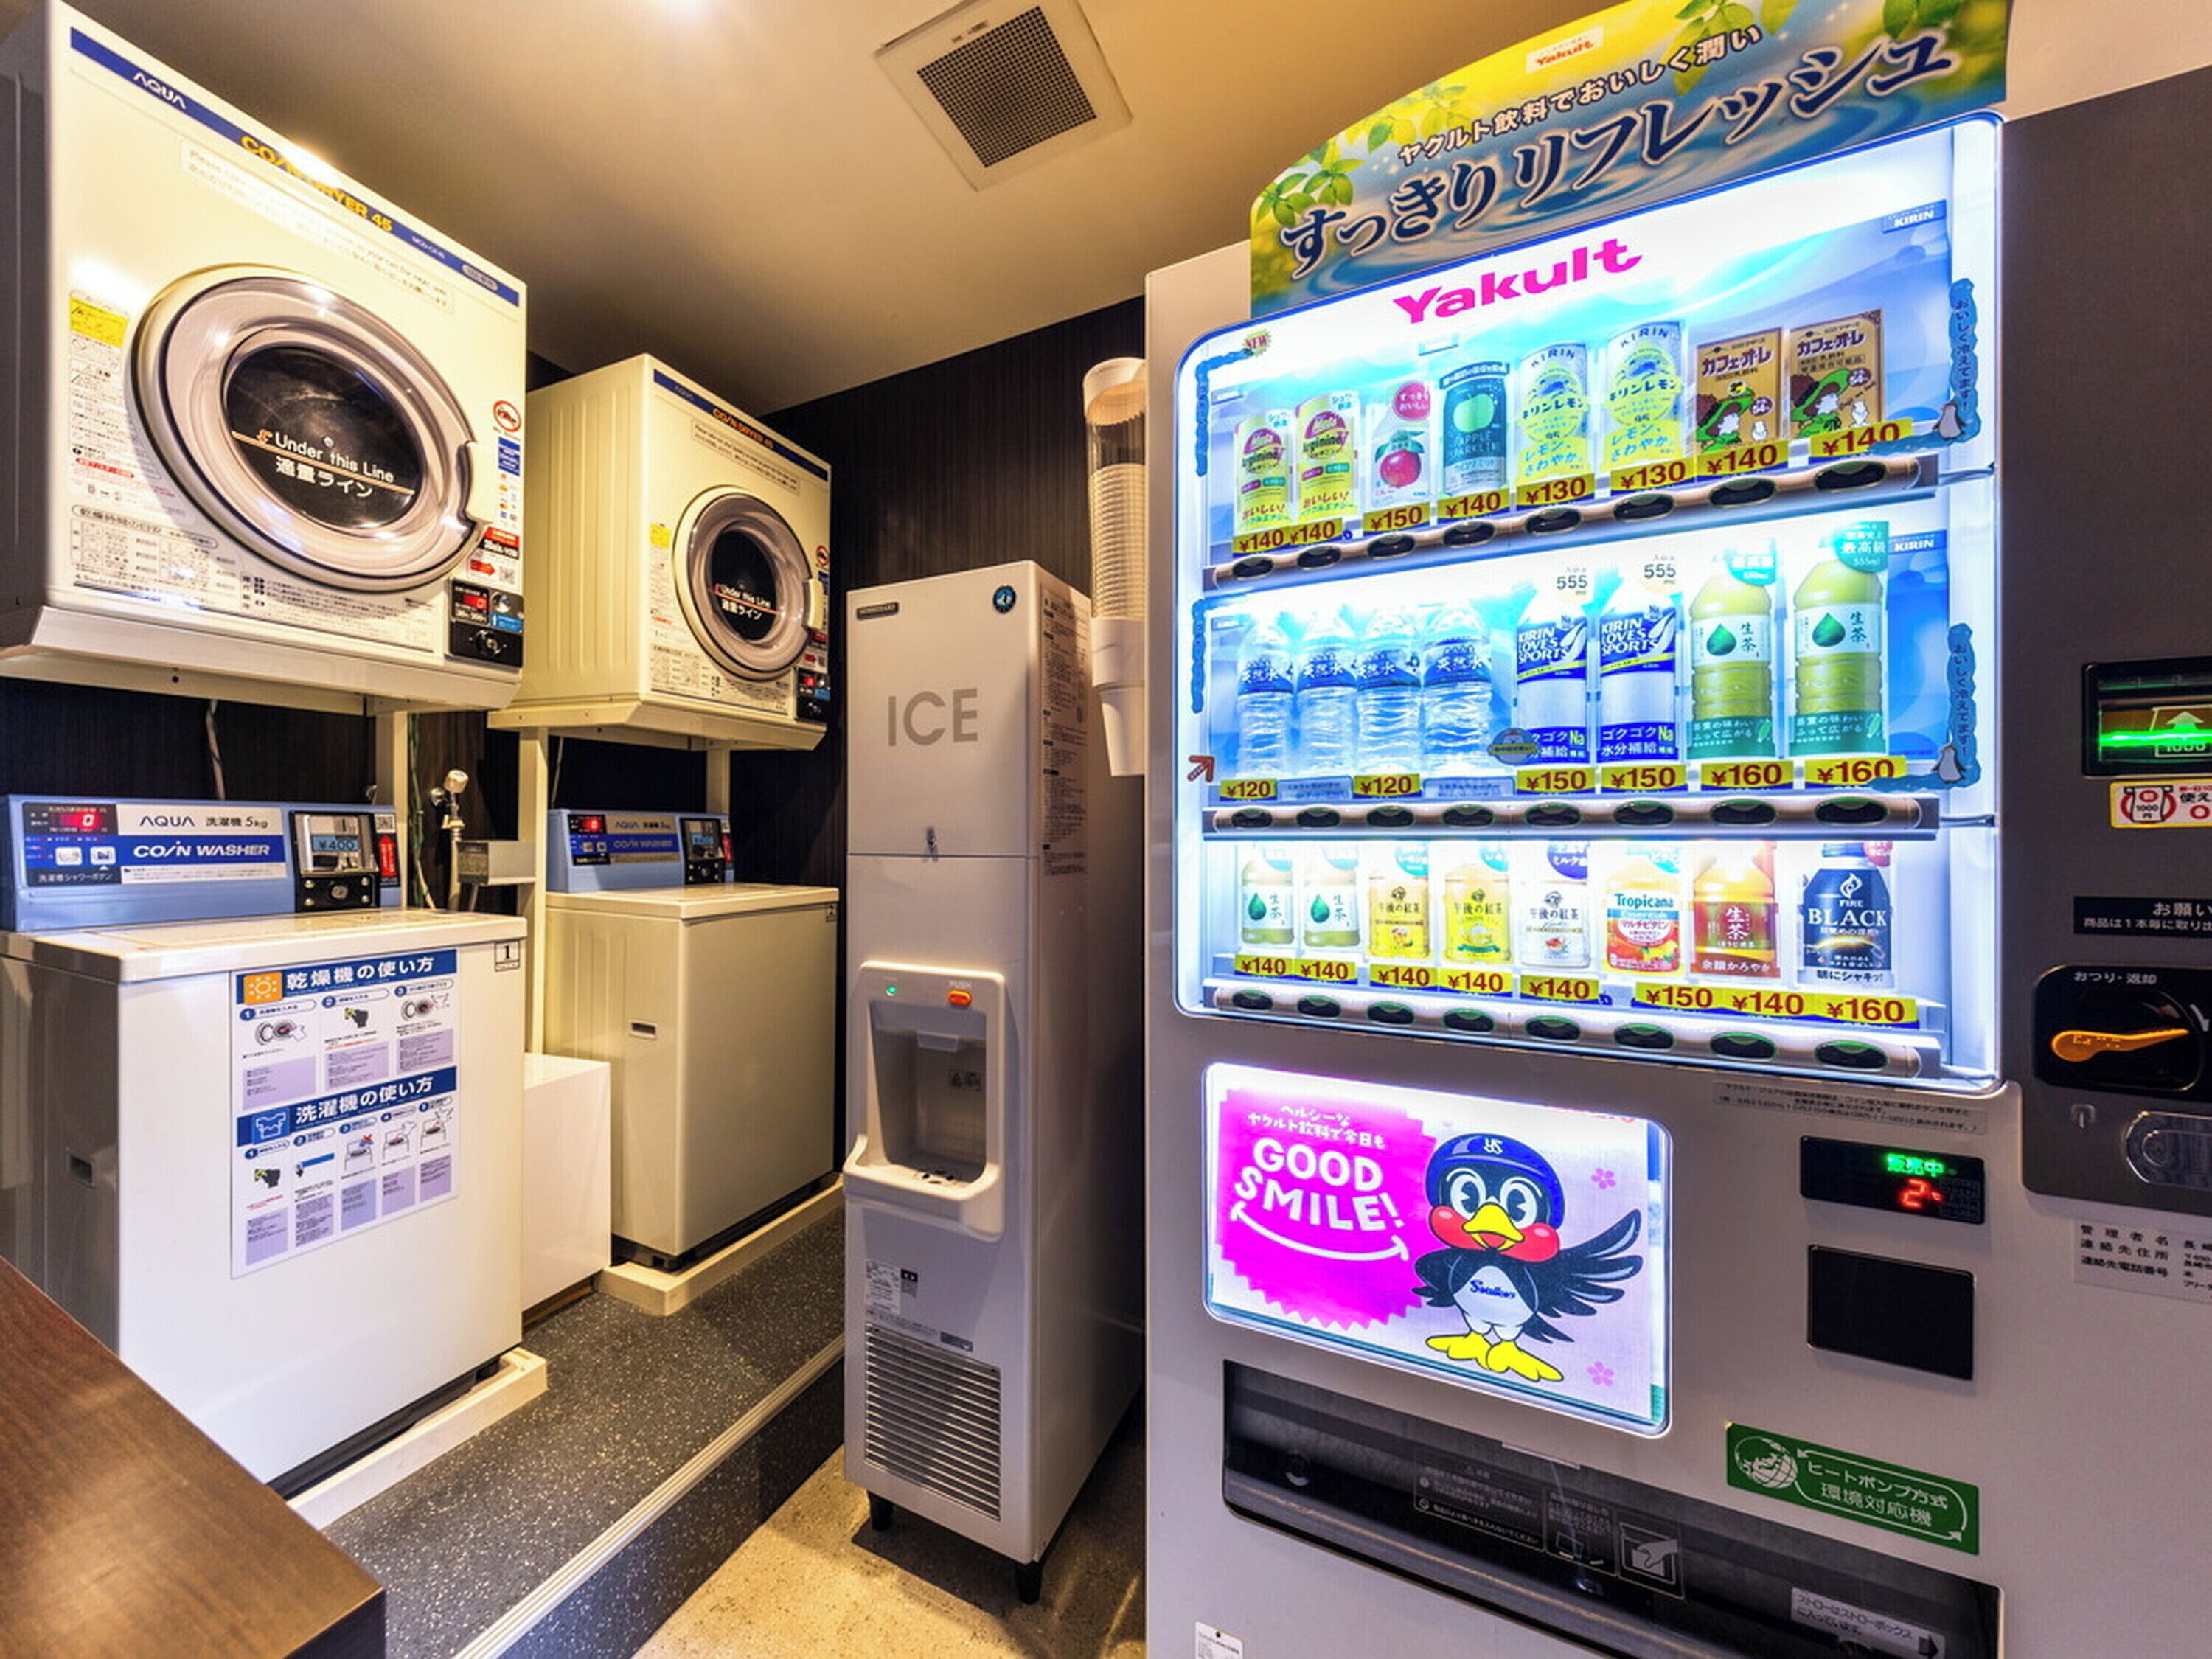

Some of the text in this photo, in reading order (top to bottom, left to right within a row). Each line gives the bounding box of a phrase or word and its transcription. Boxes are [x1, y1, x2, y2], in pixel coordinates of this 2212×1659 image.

[133, 72, 187, 110] AQUA
[1399, 24, 1762, 166] ヤクルト飲料でおいしく潤い
[371, 212, 393, 232] 45
[1893, 210, 1935, 228] KIRIN
[1392, 238, 1643, 324] Yakult
[1822, 422, 1901, 455] ¥140
[275, 431, 394, 484] Under this Line
[1707, 444, 1778, 476] ¥140
[1621, 461, 1686, 489] ¥130
[1526, 477, 1586, 504] ¥130
[1446, 492, 1501, 518] ¥140
[1371, 506, 1422, 532] ¥150
[1239, 529, 1284, 552] ¥140
[1290, 521, 1336, 545] ¥140
[1893, 539, 1935, 553] KIRIN
[1643, 563, 1677, 580] 555
[1557, 575, 1588, 591] 555
[1518, 627, 1556, 641] KIRIN
[1601, 617, 1644, 634] KIRIN
[1739, 620, 1757, 653] 生茶
[1850, 610, 1868, 644] 生茶
[887, 687, 979, 748] ICE
[1659, 726, 1674, 742] Na
[1601, 742, 1658, 757] 水分補給
[1526, 770, 1587, 791] ¥150
[1611, 766, 1677, 788] ¥150
[1711, 762, 1783, 786] ¥160
[1816, 759, 1895, 783] ¥160
[1227, 780, 1270, 799] ¥120
[1360, 776, 1412, 796] ¥120
[81, 813, 95, 827] 0
[139, 815, 195, 827] AQUA
[206, 816, 268, 829] 洗濯機 5kg
[133, 840, 271, 858] COIN WASHER
[1613, 892, 1674, 910] Tropicana
[1839, 899, 1864, 908] FIRE
[1725, 905, 1749, 941] 生茶
[1807, 908, 1888, 928] BLACK
[504, 944, 511, 960] 1
[285, 956, 435, 992] 乾燥機の使い方
[1241, 957, 1287, 975] ¥140
[1301, 962, 1349, 981] ¥140
[1378, 967, 1430, 987] ¥140
[1448, 972, 1503, 992] ¥140
[1528, 979, 1590, 1000] ¥140
[1646, 987, 1713, 1009] ¥150
[1732, 992, 1804, 1015] ¥140
[1826, 999, 1905, 1023] ¥160
[296, 1076, 434, 1124] 洗濯機の使い方
[1281, 1105, 1351, 1127] ヘルシーな
[1247, 1112, 1386, 1150] ヤクルト飲料で今日も
[1253, 1137, 1383, 1192] GOOD
[1234, 1165, 1405, 1231] SMILE!
[1807, 1461, 1948, 1510] ヒートポンプ方式
[1820, 1482, 1933, 1528] 環境対応機
